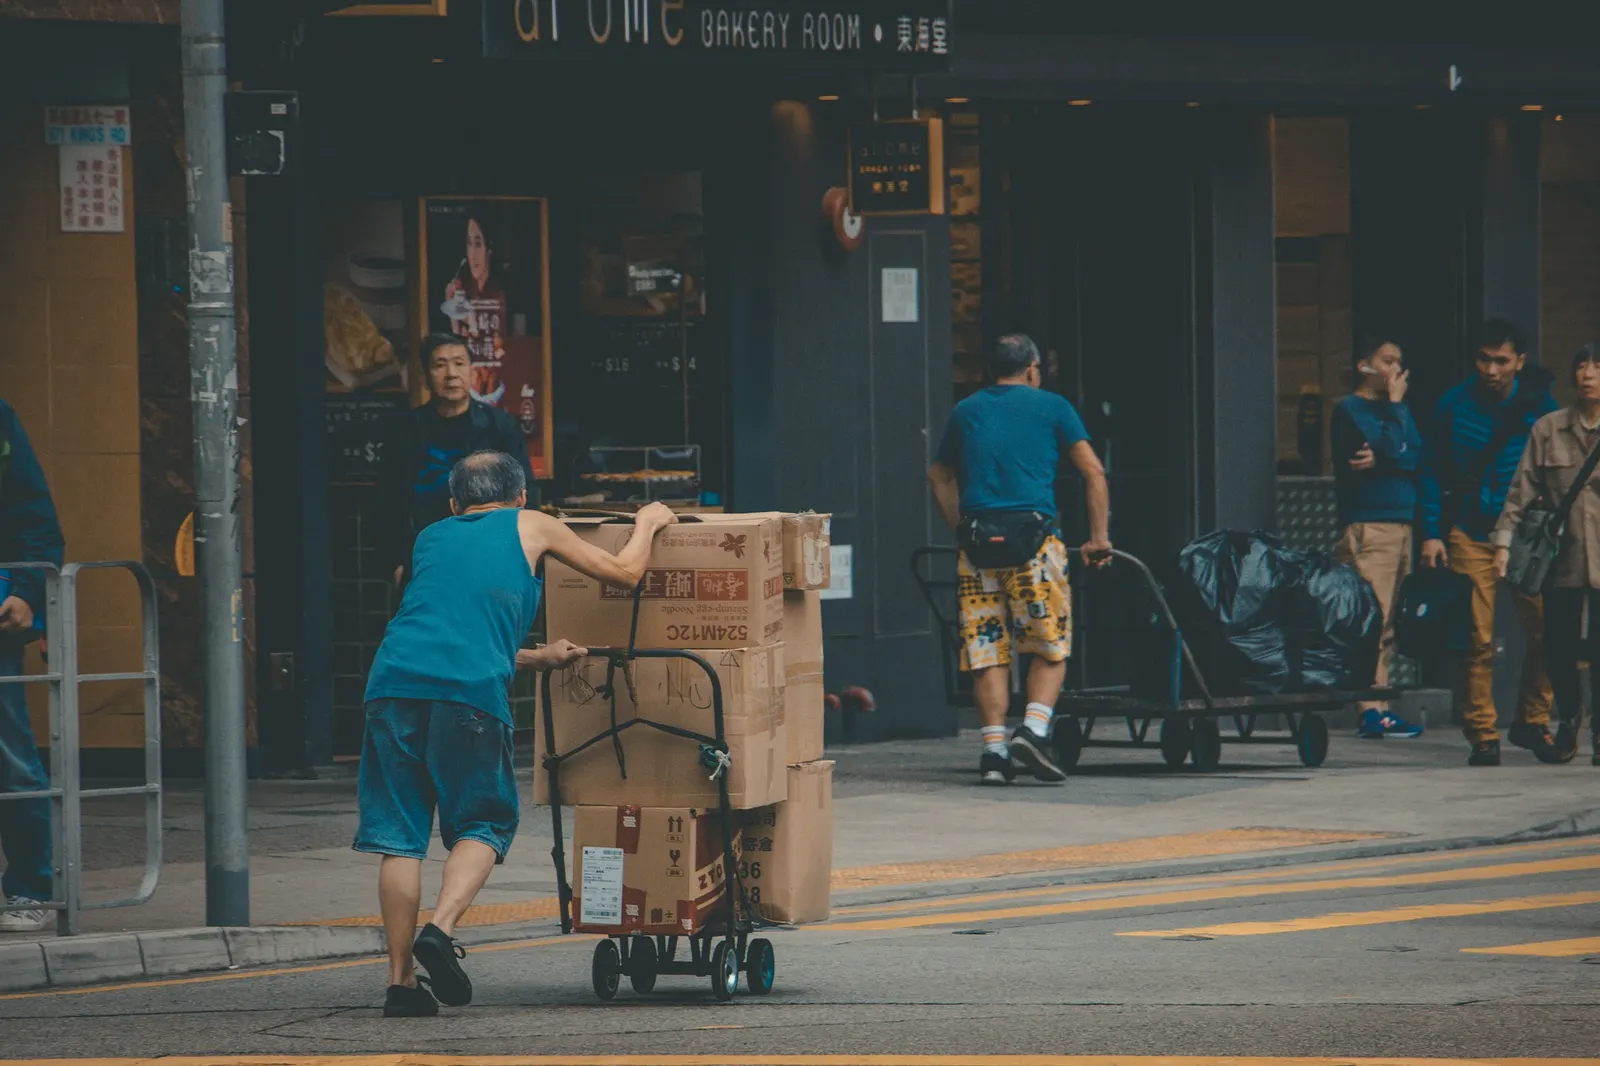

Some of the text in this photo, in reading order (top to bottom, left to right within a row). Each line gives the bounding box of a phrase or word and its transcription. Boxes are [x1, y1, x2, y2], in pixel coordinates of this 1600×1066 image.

[701, 9, 789, 48] BAKERY
[802, 12, 860, 50] ROOM
[896, 15, 948, 55] 東海堂
[660, 605, 694, 615] Noodle
[666, 624, 748, 641] 524M12C
